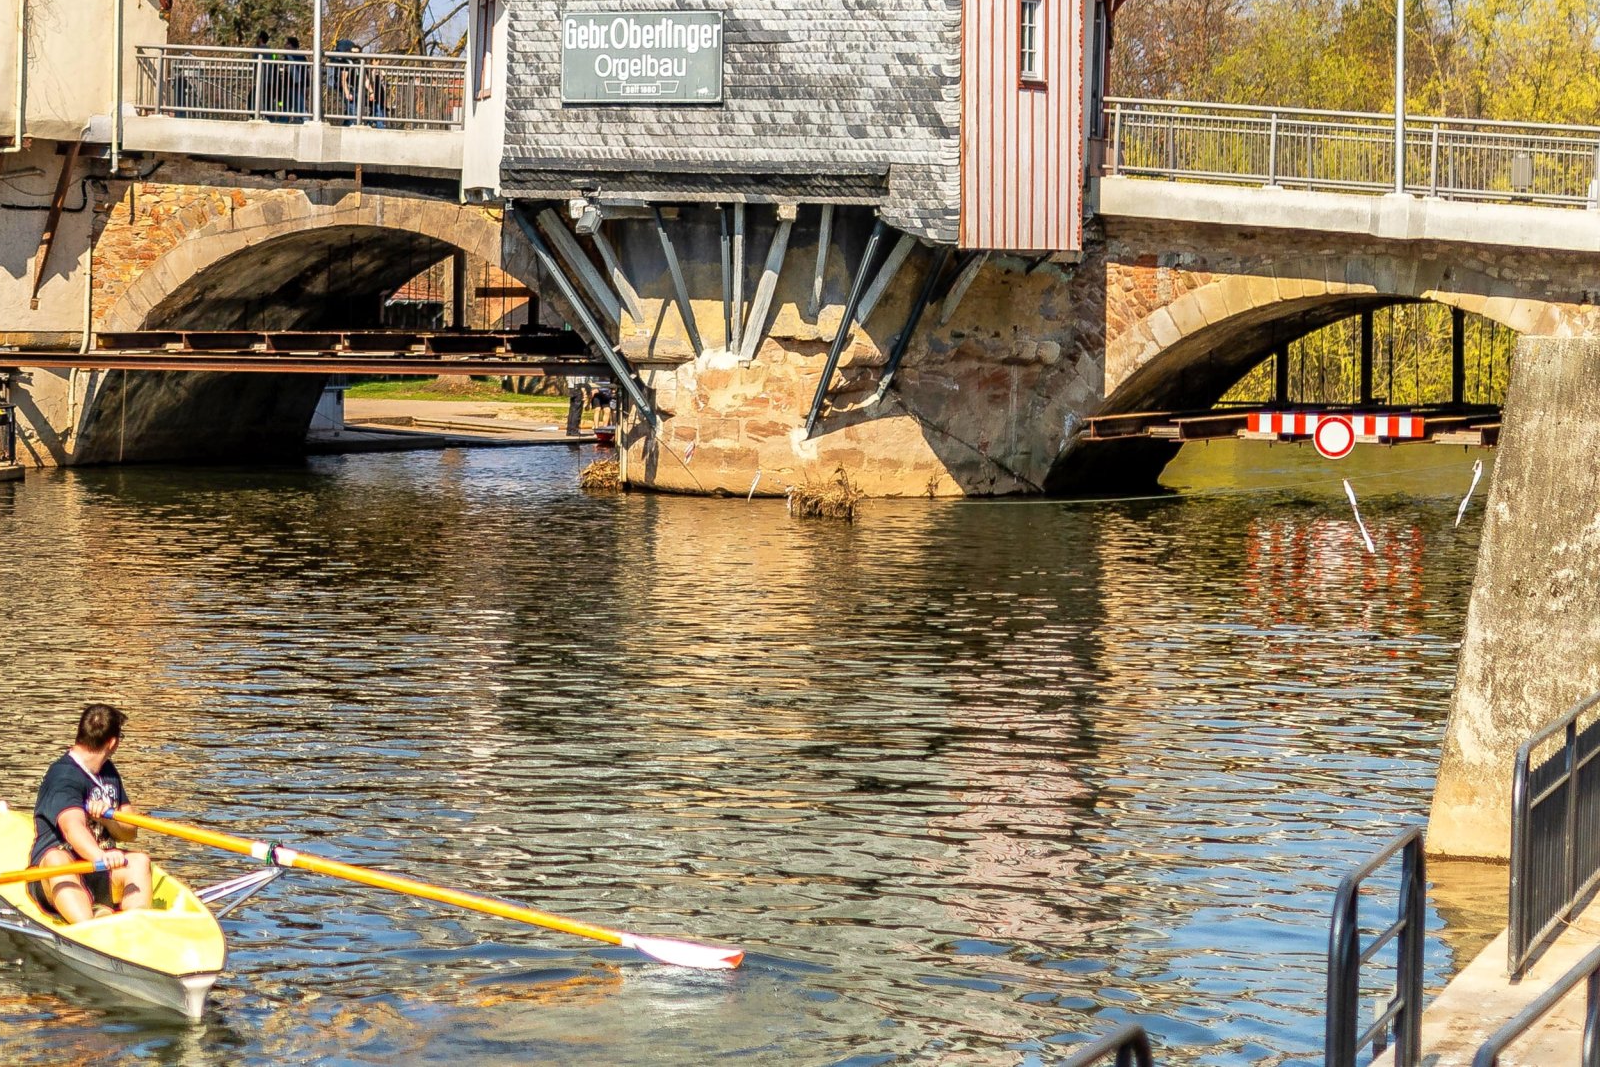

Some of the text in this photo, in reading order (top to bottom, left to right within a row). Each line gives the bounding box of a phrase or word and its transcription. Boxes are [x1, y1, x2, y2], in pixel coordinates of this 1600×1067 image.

[564, 17, 721, 54] Gebr. Oberlinger
[594, 54, 687, 81] Orgelbau
